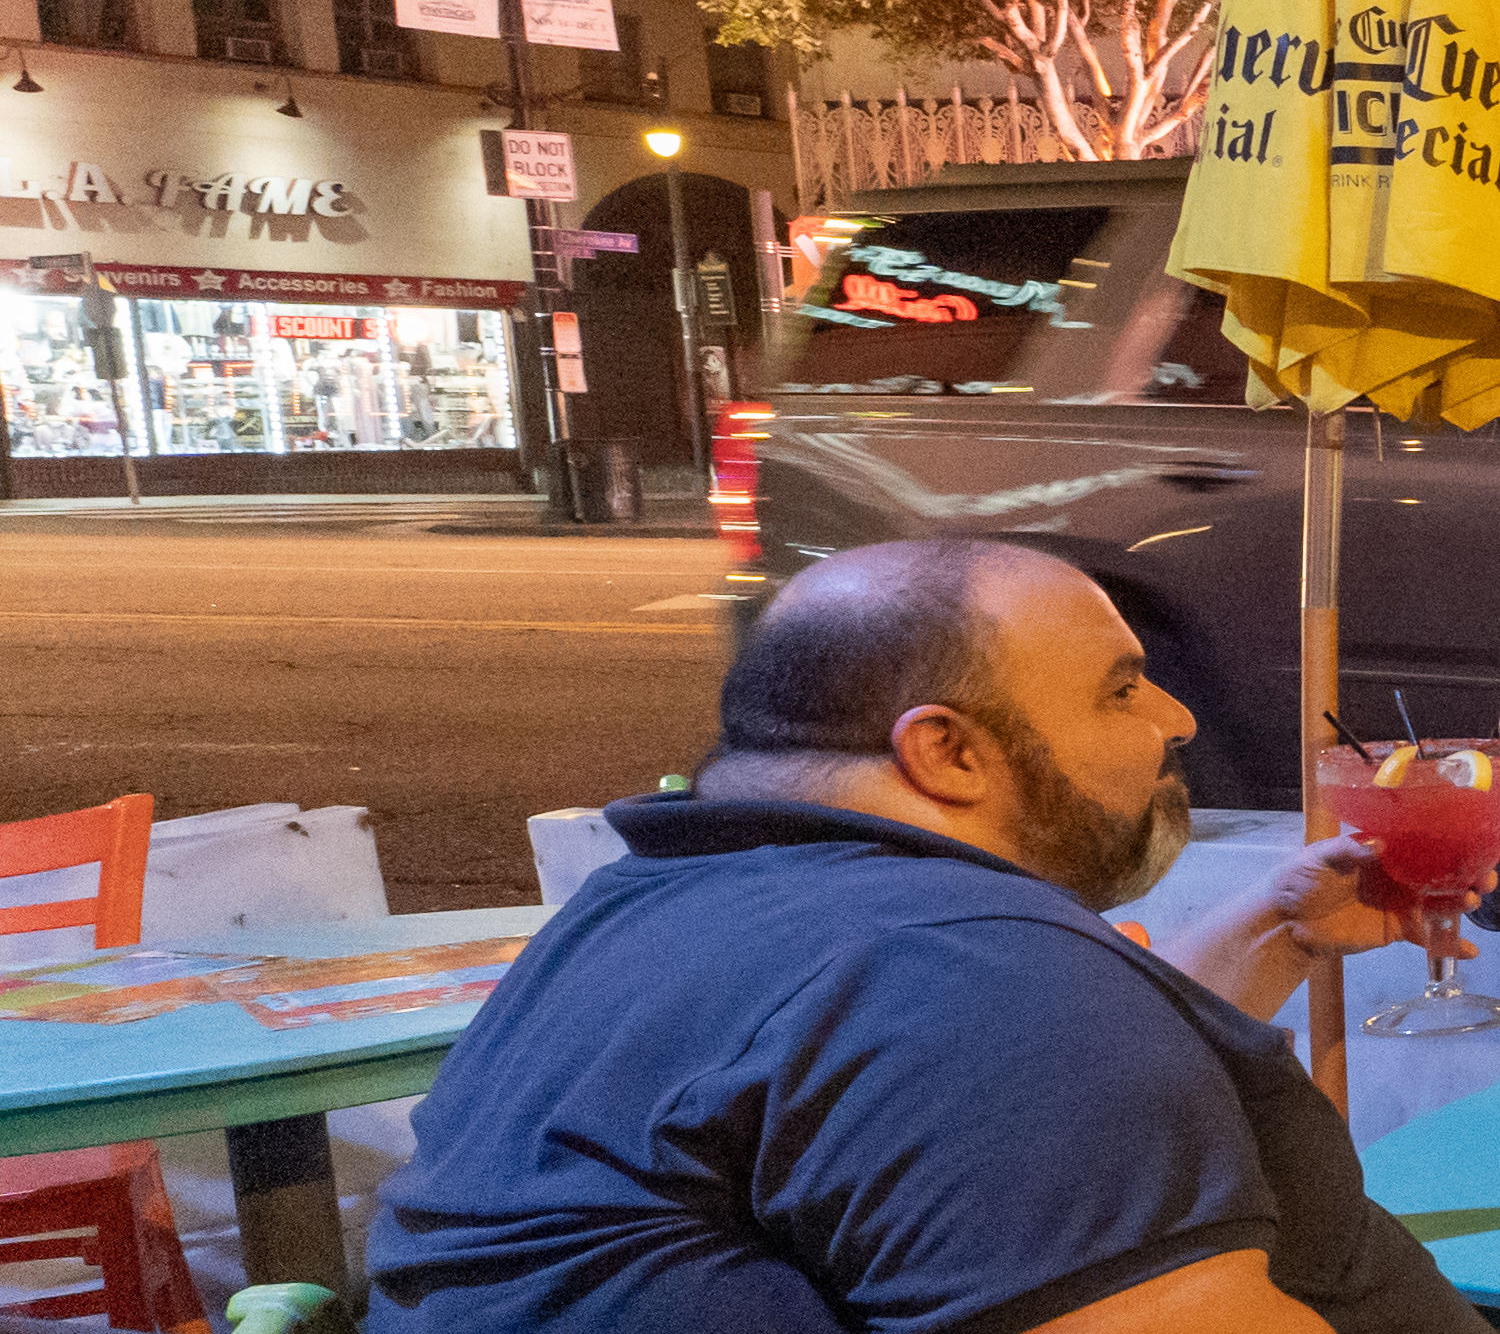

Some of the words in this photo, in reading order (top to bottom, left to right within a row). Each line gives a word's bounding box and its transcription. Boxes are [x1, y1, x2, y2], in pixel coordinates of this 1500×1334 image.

[508, 139, 530, 155] DO
[537, 141, 565, 157] NOT
[513, 160, 568, 178] BLOCK
[238, 270, 370, 297] Accessories
[421, 280, 498, 300] Fashion
